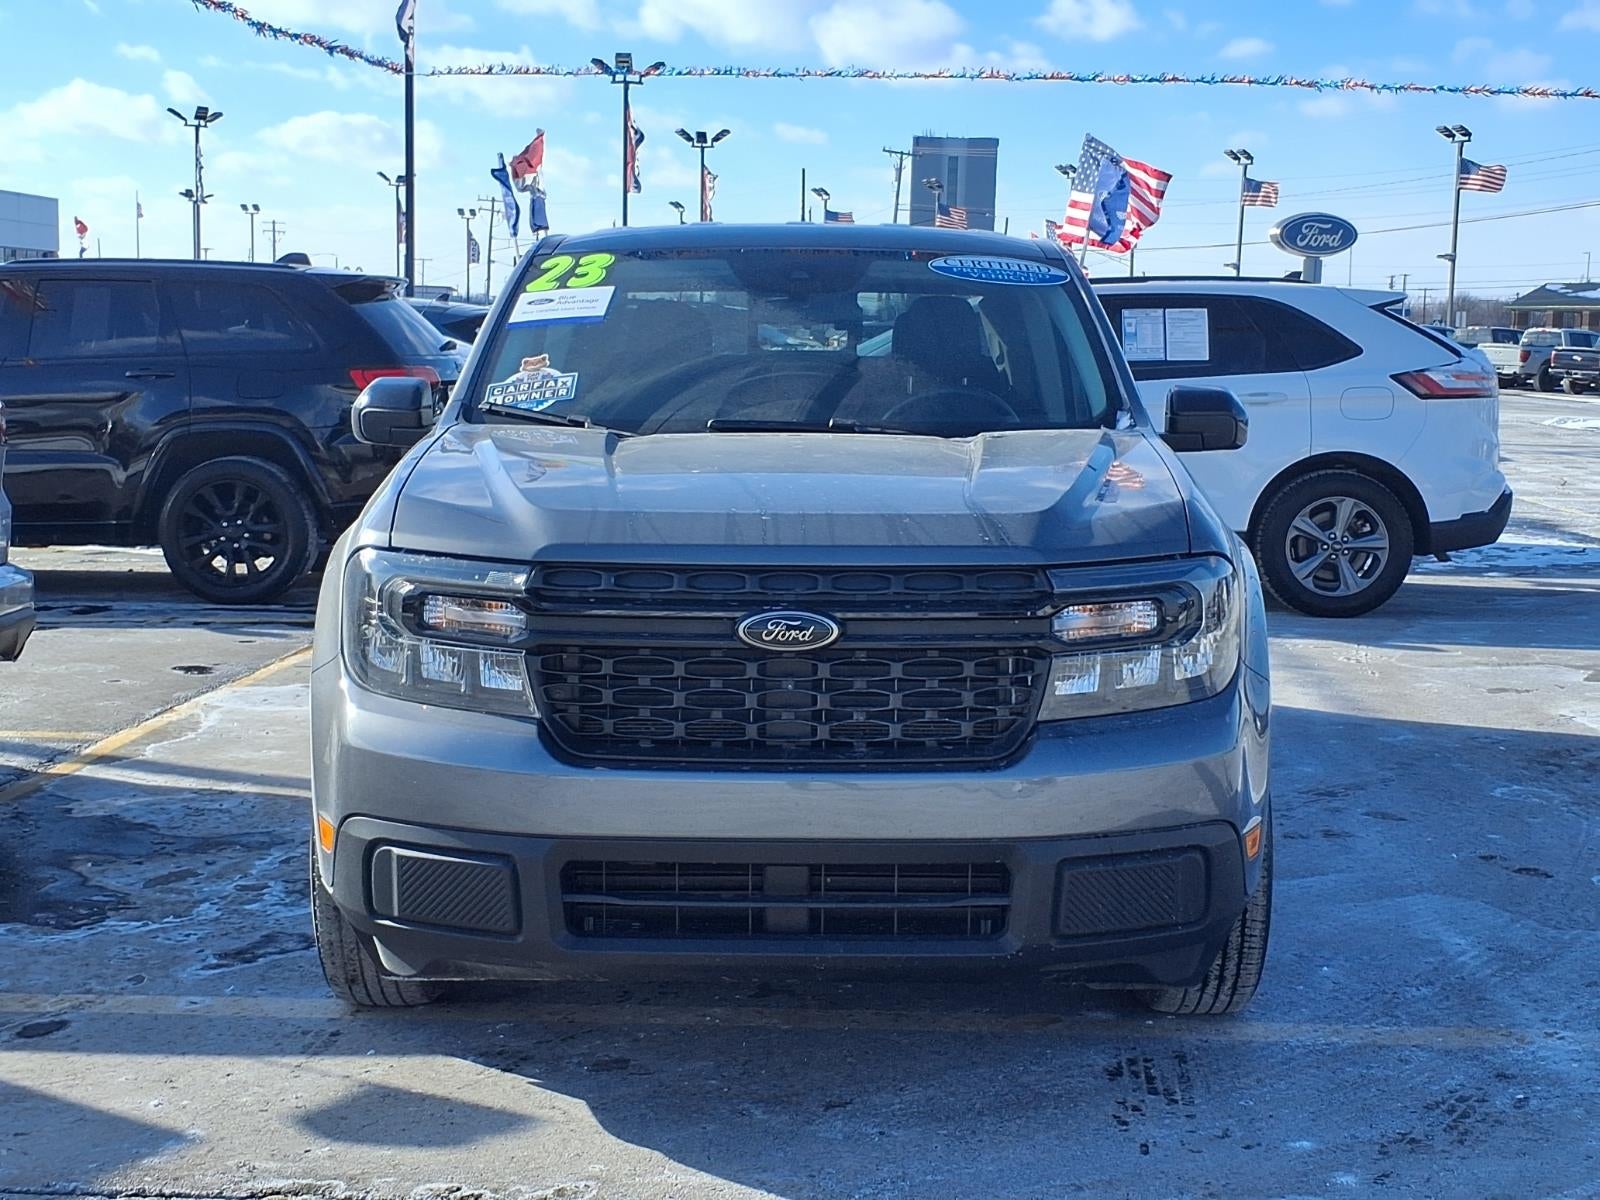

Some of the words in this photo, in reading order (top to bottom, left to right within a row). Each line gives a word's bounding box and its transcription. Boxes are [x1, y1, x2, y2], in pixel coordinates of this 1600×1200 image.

[1297, 222, 1344, 247] Ford
[526, 253, 616, 292] 23
[943, 259, 1051, 274] CERTIFIED
[952, 267, 1050, 279] PRE-OWNED
[493, 379, 569, 395] CARFAX
[504, 389, 567, 404] OWNER
[762, 619, 815, 641] Ford
